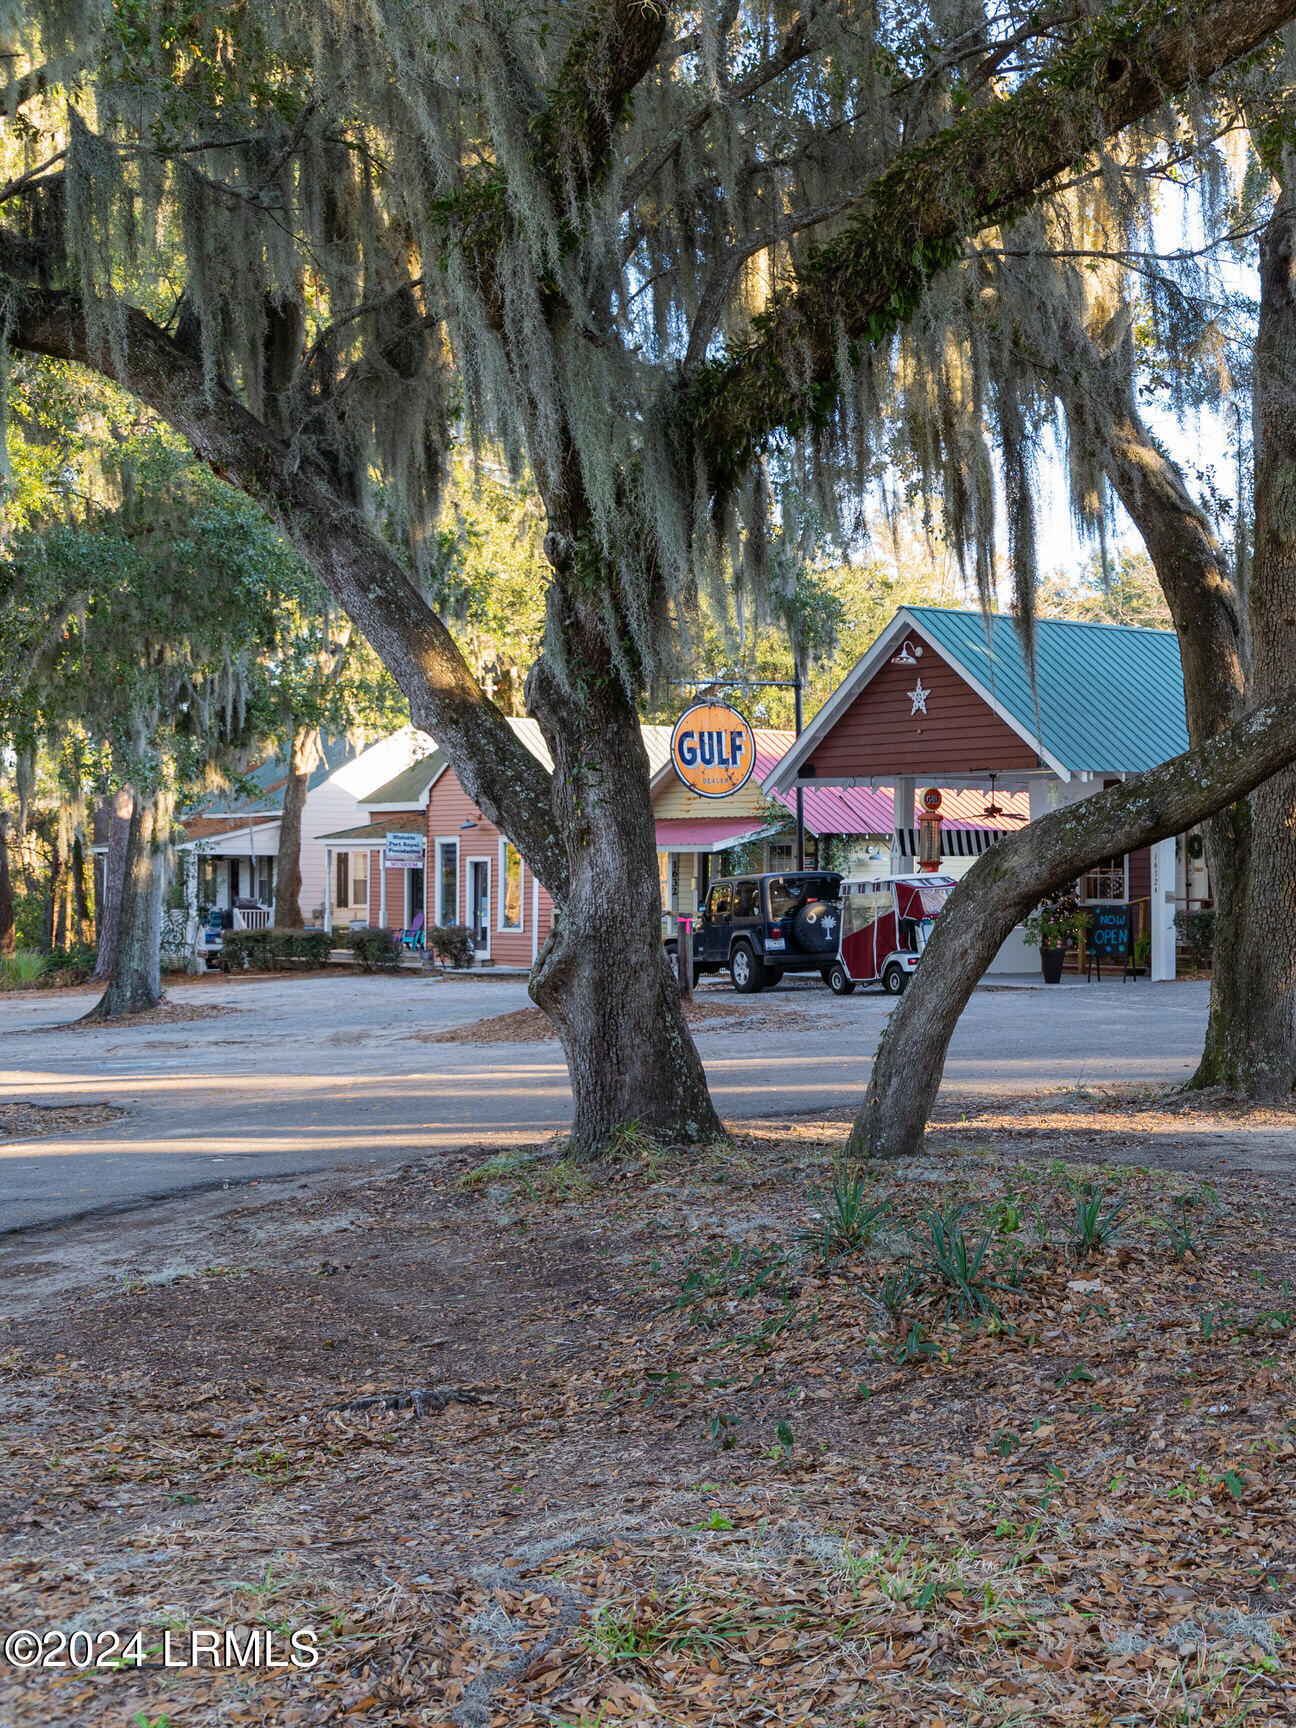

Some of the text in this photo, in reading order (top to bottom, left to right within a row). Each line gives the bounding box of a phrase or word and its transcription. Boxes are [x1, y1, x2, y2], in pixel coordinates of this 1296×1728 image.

[678, 730, 747, 769] GULF
[1100, 914, 1126, 925] NOW
[1094, 929, 1128, 944] OPEN
